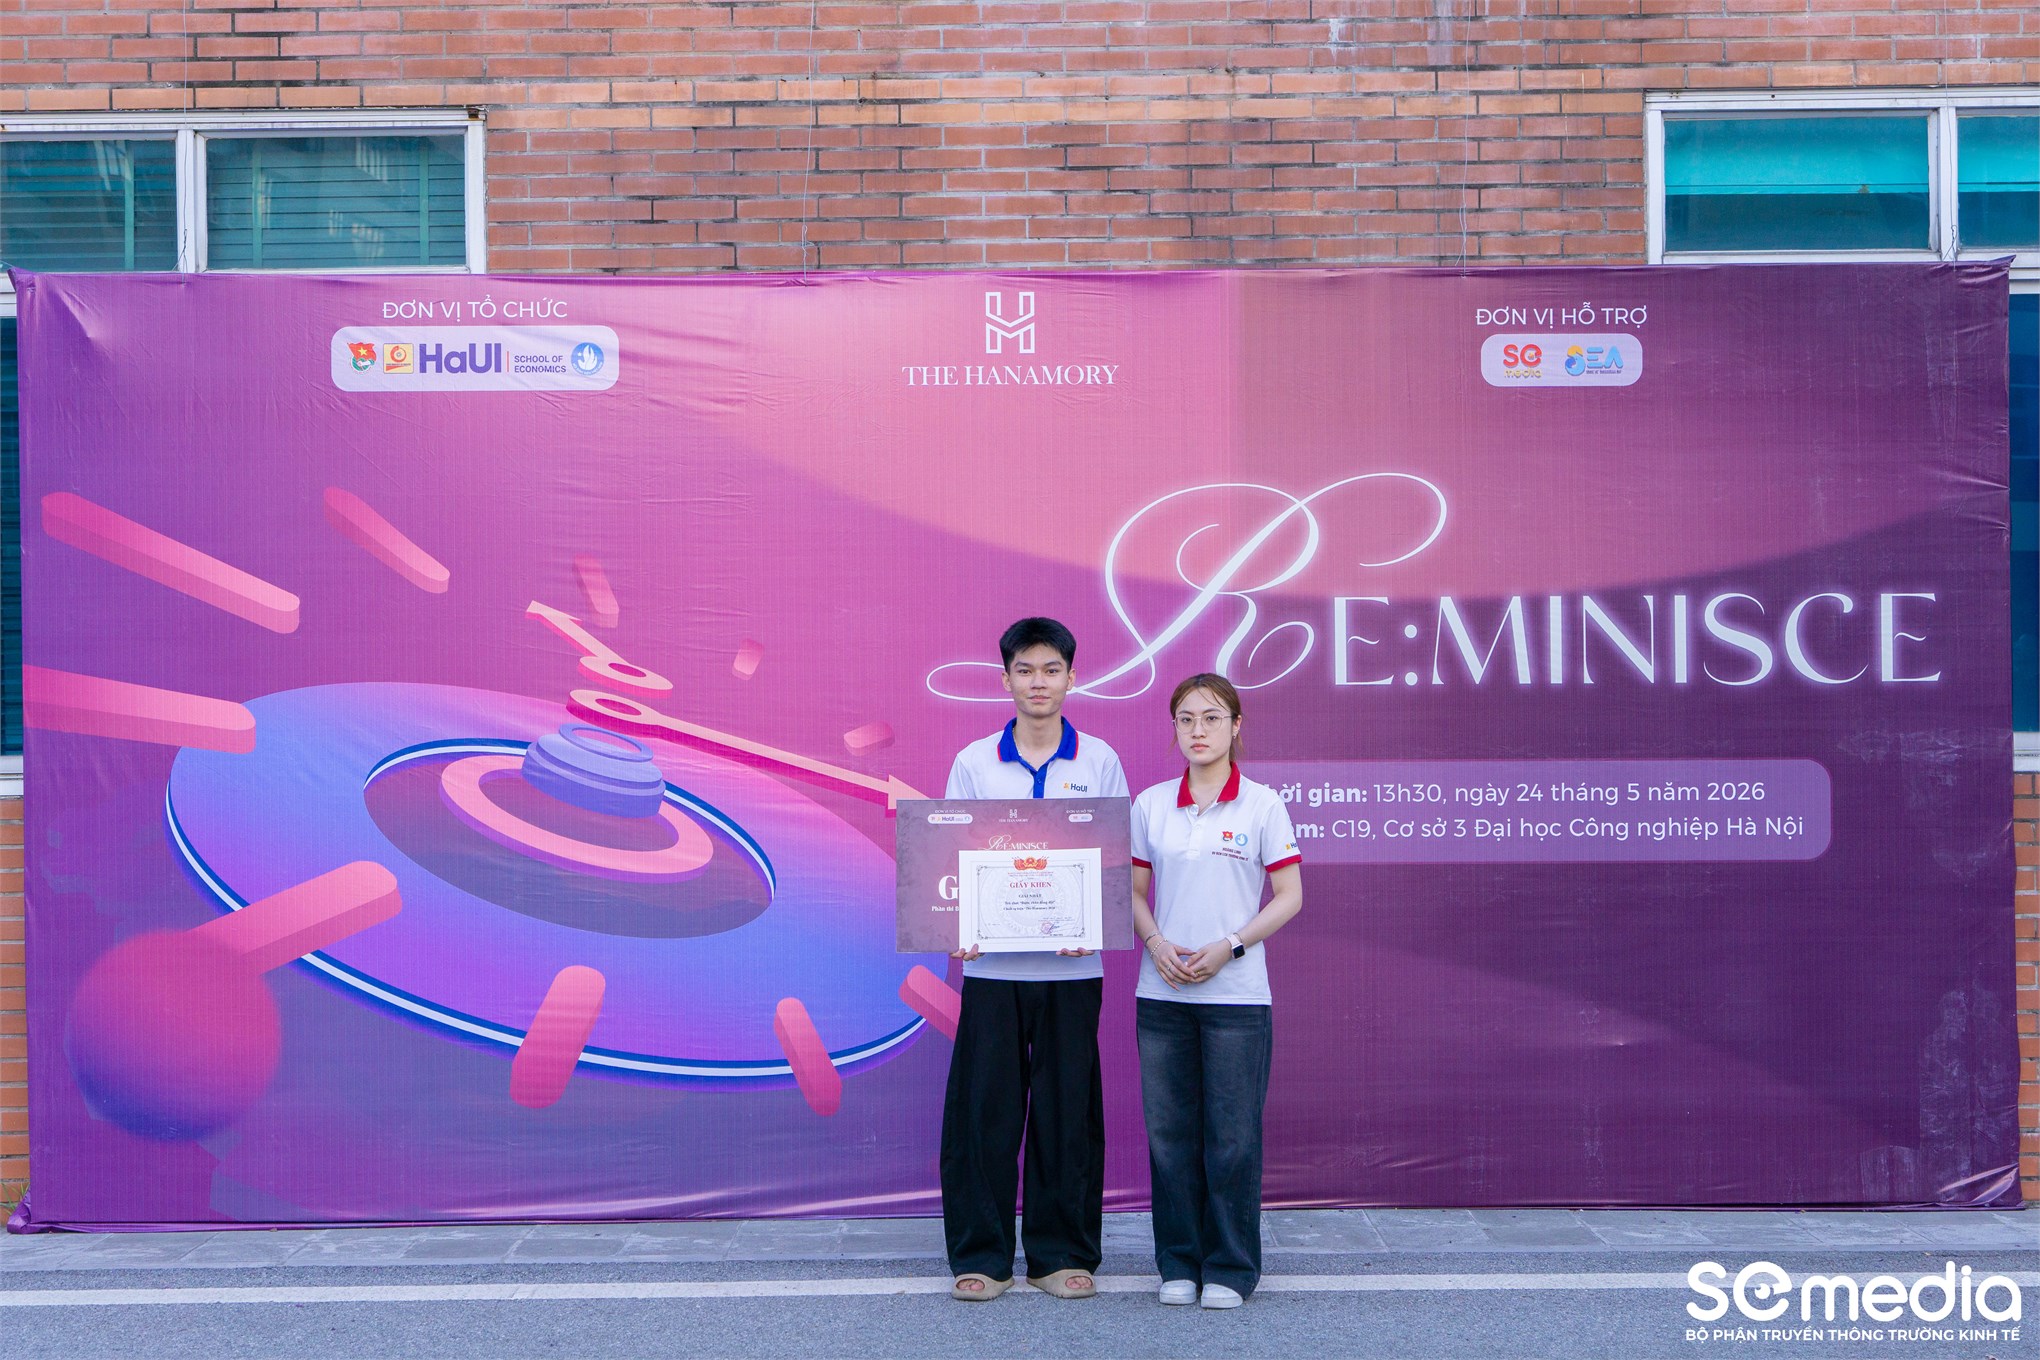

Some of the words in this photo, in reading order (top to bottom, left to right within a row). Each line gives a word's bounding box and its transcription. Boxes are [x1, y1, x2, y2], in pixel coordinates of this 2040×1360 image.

[382, 299, 433, 319] ĐƠN
[440, 301, 461, 322] VỊ
[467, 294, 496, 319] TỔ
[503, 298, 568, 319] CHỨC
[1475, 306, 1527, 326] ĐƠN
[1533, 308, 1554, 329] VỊ
[1562, 301, 1596, 325] HỖ
[1601, 305, 1647, 329] TRỢ
[514, 355, 550, 363] SCHOOL
[552, 355, 564, 363] OF
[514, 365, 567, 373] ECONOMICS
[902, 366, 958, 386] THE
[964, 365, 1119, 385] HANAMORY
[1263, 783, 1302, 803] ời
[1308, 782, 1368, 808] gian:
[1373, 784, 1447, 805] 13h30,
[1455, 784, 1510, 807] ngày
[1517, 784, 1544, 802] 24
[1551, 782, 1618, 806] tháng
[1627, 783, 1640, 801] 5
[1648, 782, 1700, 801] năm
[1707, 782, 1765, 801] 2026
[1332, 819, 1376, 840] C19,
[1383, 820, 1414, 838] Cơ
[1421, 817, 1447, 837] sở
[1454, 819, 1467, 838] 3
[1474, 819, 1512, 841] Đại
[1520, 818, 1561, 841] học
[1569, 818, 1629, 841] Công
[1638, 816, 1719, 840] nghiệp
[1727, 817, 1757, 836] Hà
[1766, 816, 1803, 840] Nội
